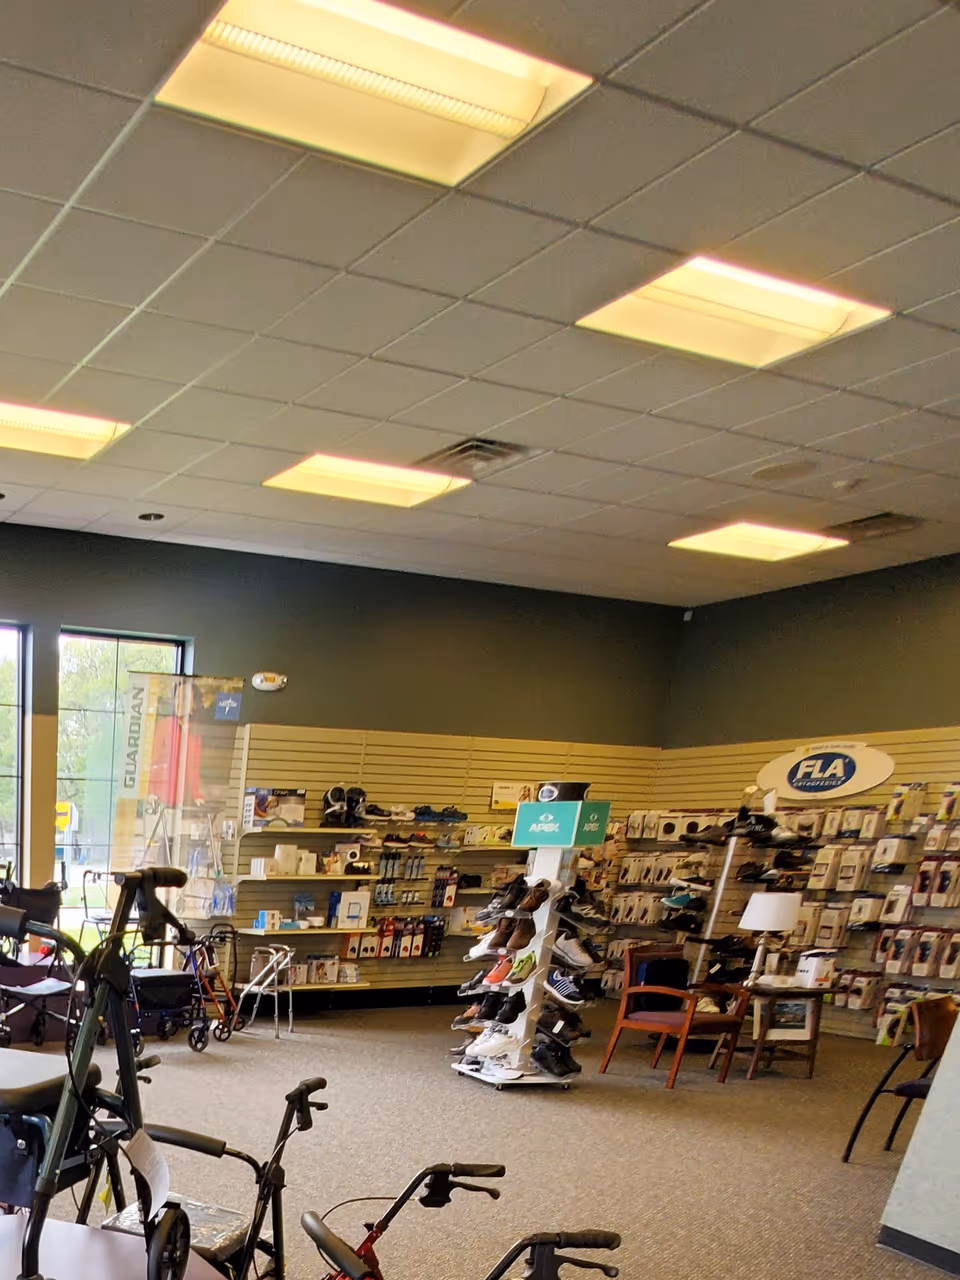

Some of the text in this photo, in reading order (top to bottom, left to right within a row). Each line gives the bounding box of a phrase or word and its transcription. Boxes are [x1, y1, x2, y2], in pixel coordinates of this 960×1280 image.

[123, 686, 145, 789] GUARDIAN
[796, 758, 845, 779] FLA
[528, 822, 560, 833] APEX
